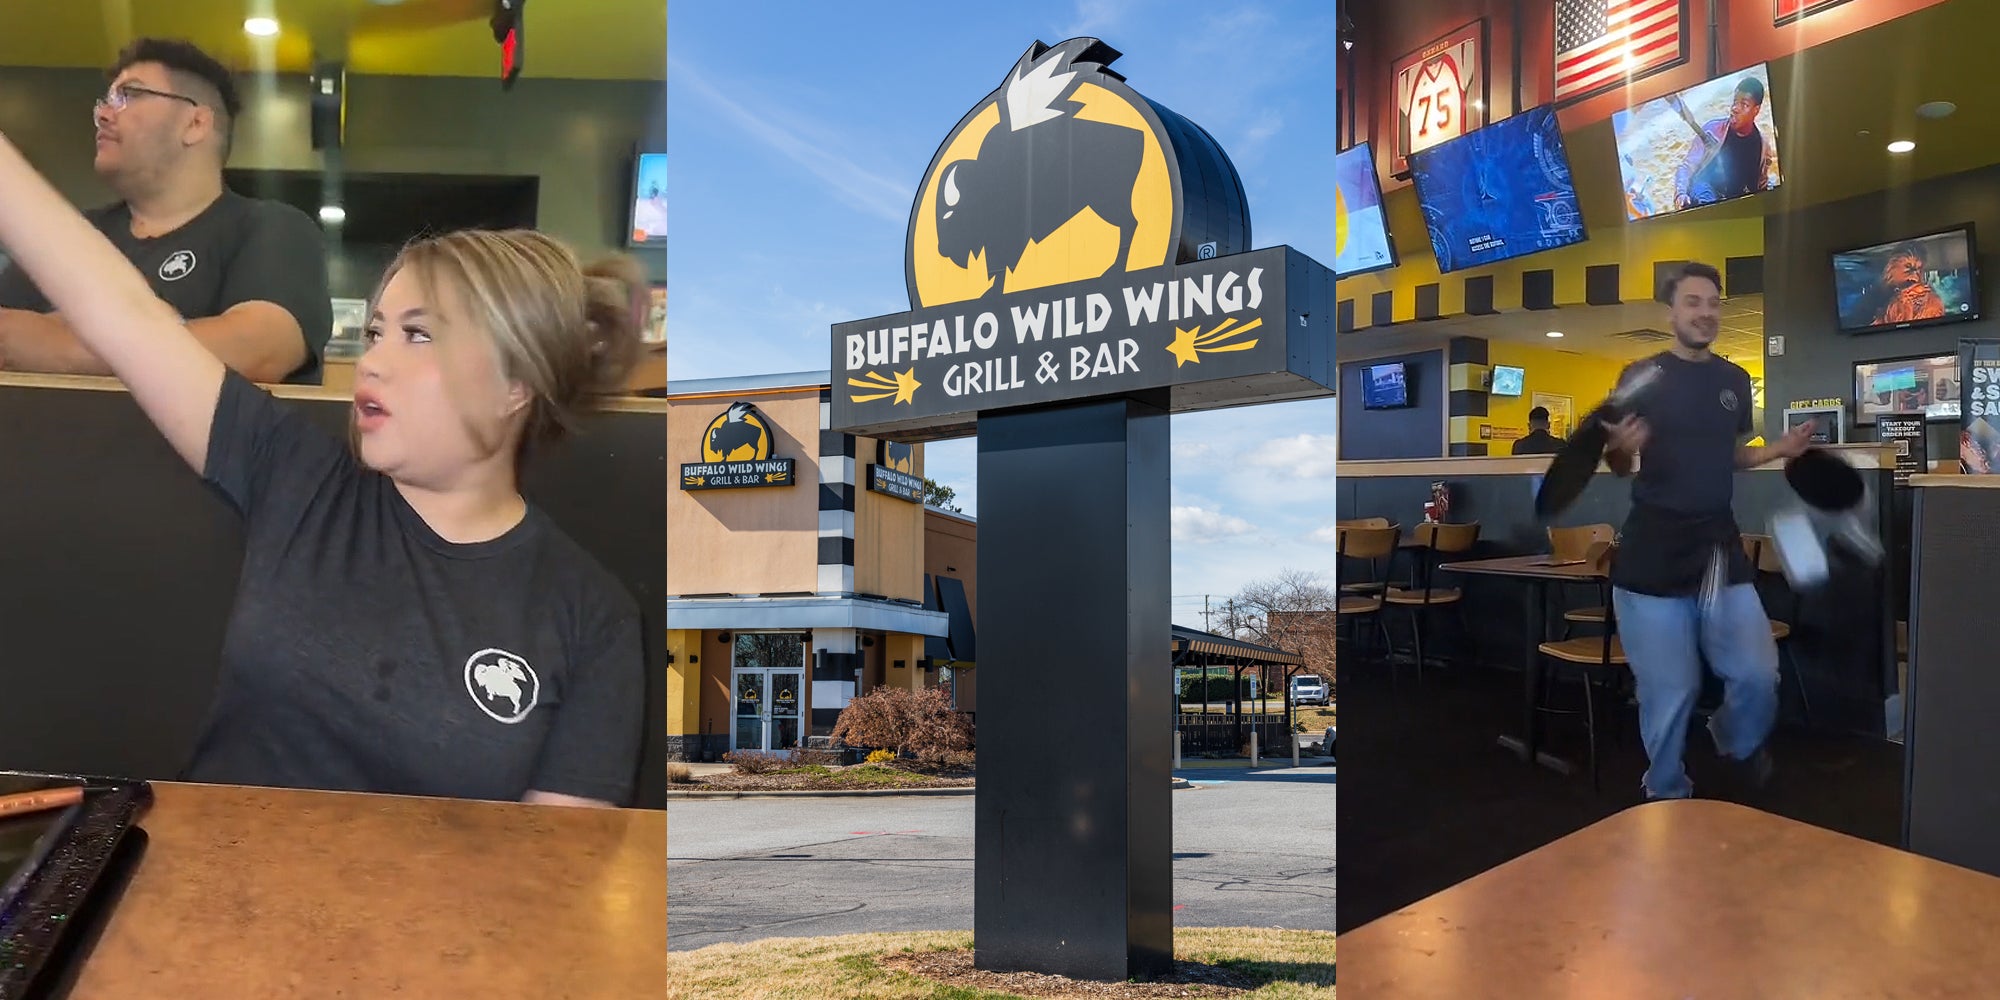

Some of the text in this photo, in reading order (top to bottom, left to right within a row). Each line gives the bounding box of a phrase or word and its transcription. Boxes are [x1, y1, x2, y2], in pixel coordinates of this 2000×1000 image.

[1418, 87, 1450, 136] 75
[846, 267, 1264, 371] BUFFALO WILD WINGS
[942, 338, 1140, 397] GRILL & BAR
[1812, 398, 1841, 407] CARDS
[1970, 401, 2000, 416] SA
[684, 462, 787, 477] BUFFALO WILD WINGS
[875, 467, 897, 482] BUFFALO
[710, 475, 760, 485] GRILL & BAR
